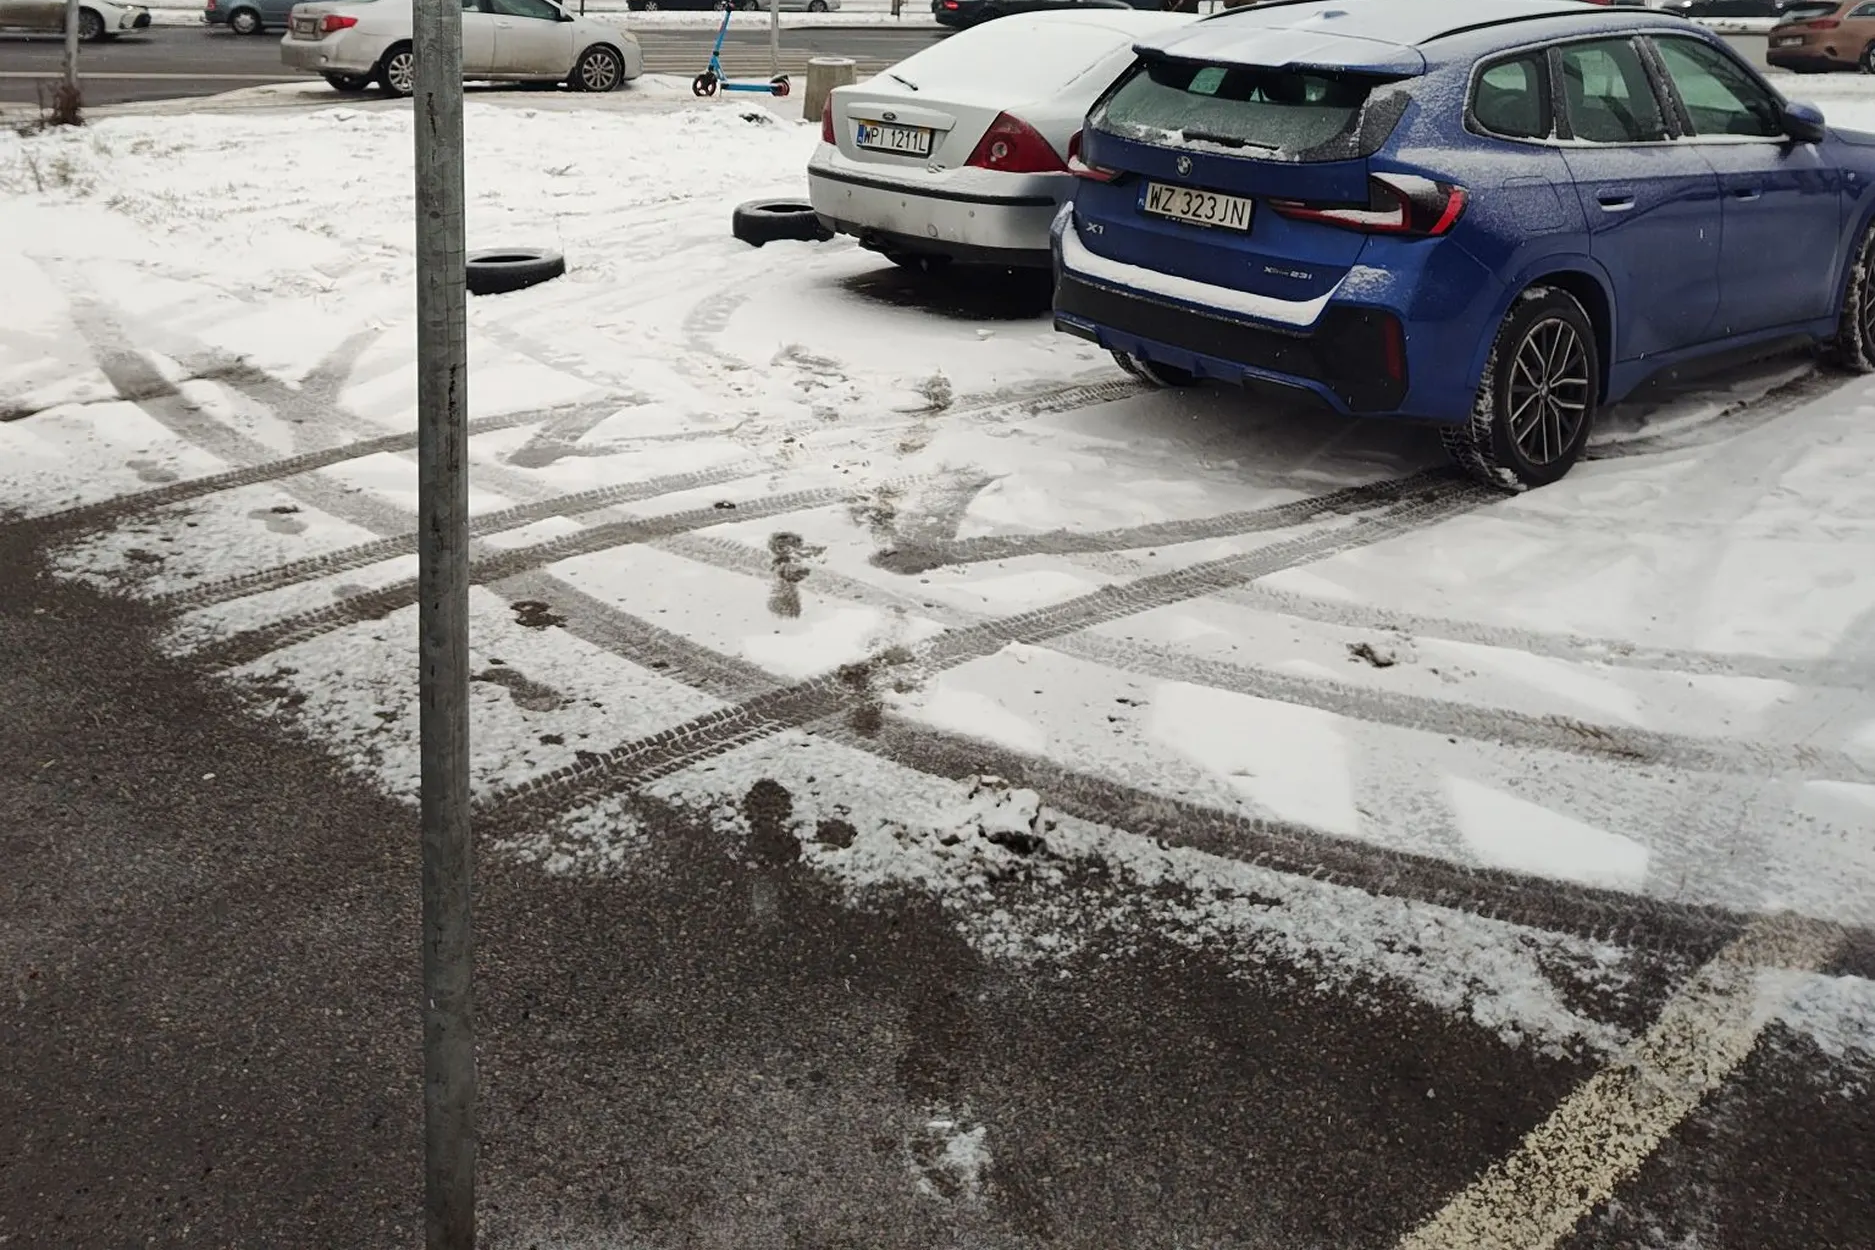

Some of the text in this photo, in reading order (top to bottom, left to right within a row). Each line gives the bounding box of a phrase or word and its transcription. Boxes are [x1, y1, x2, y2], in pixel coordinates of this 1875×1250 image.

[863, 126, 926, 152] WPI 1211L
[1149, 185, 1176, 212] WZ
[1180, 192, 1246, 226] 323JN
[1085, 222, 1104, 235] X1
